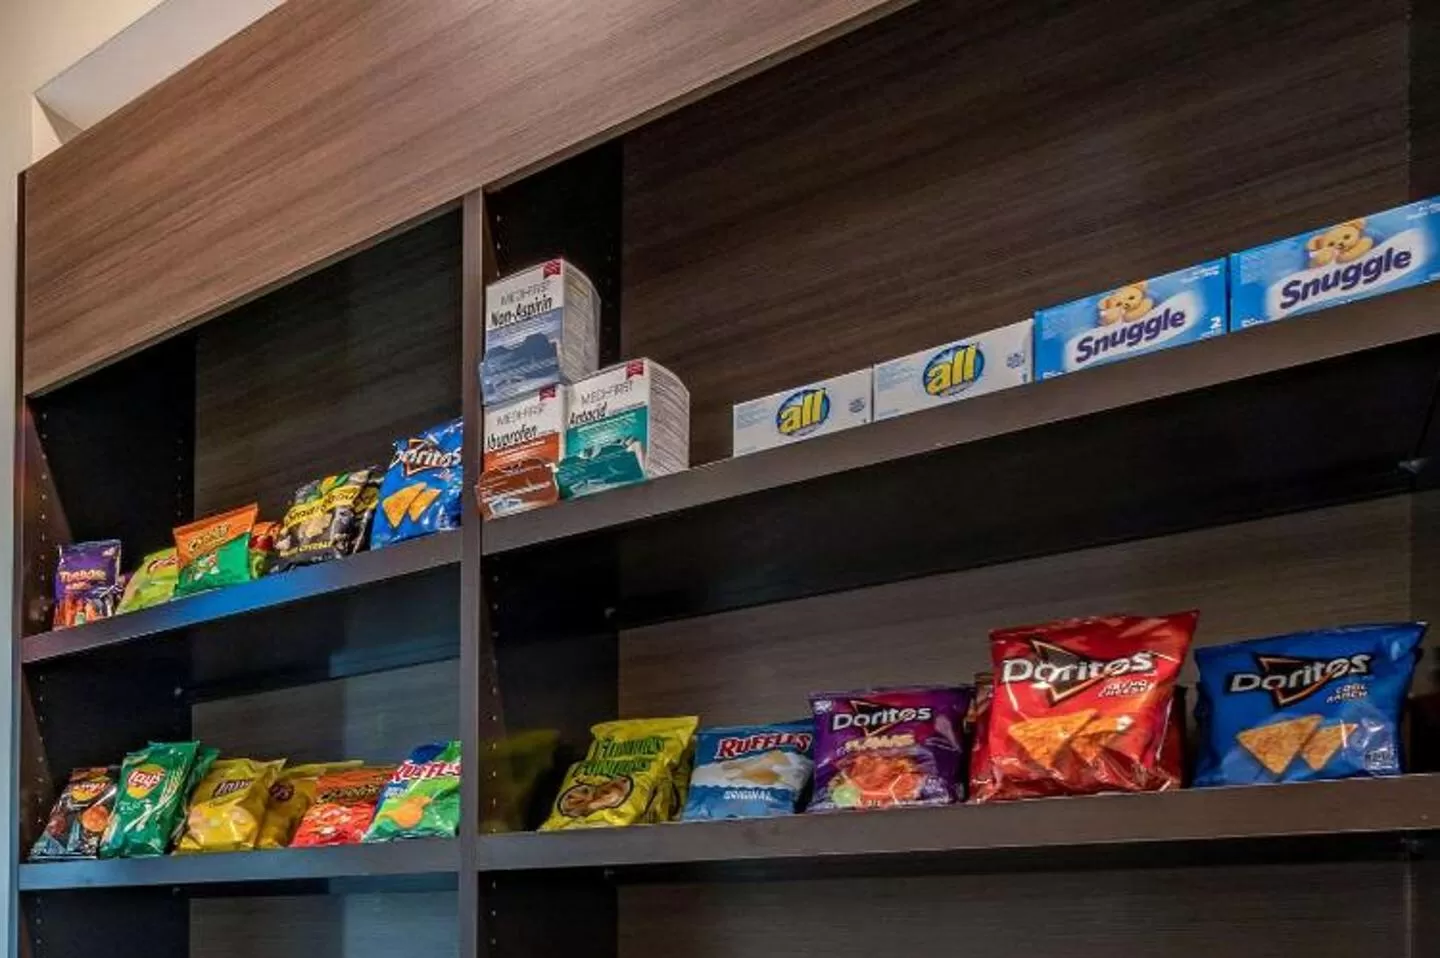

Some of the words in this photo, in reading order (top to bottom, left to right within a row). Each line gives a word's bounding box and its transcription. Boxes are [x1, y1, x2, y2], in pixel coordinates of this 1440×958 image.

[1279, 246, 1412, 310] Snuggle
[1075, 308, 1186, 364] Snuggle
[926, 344, 979, 395] all
[779, 390, 826, 435] all
[1002, 651, 1154, 683] Doritos
[1229, 653, 1372, 693] Doritos
[831, 706, 933, 731] Doritos
[716, 731, 814, 760] RUFFLES
